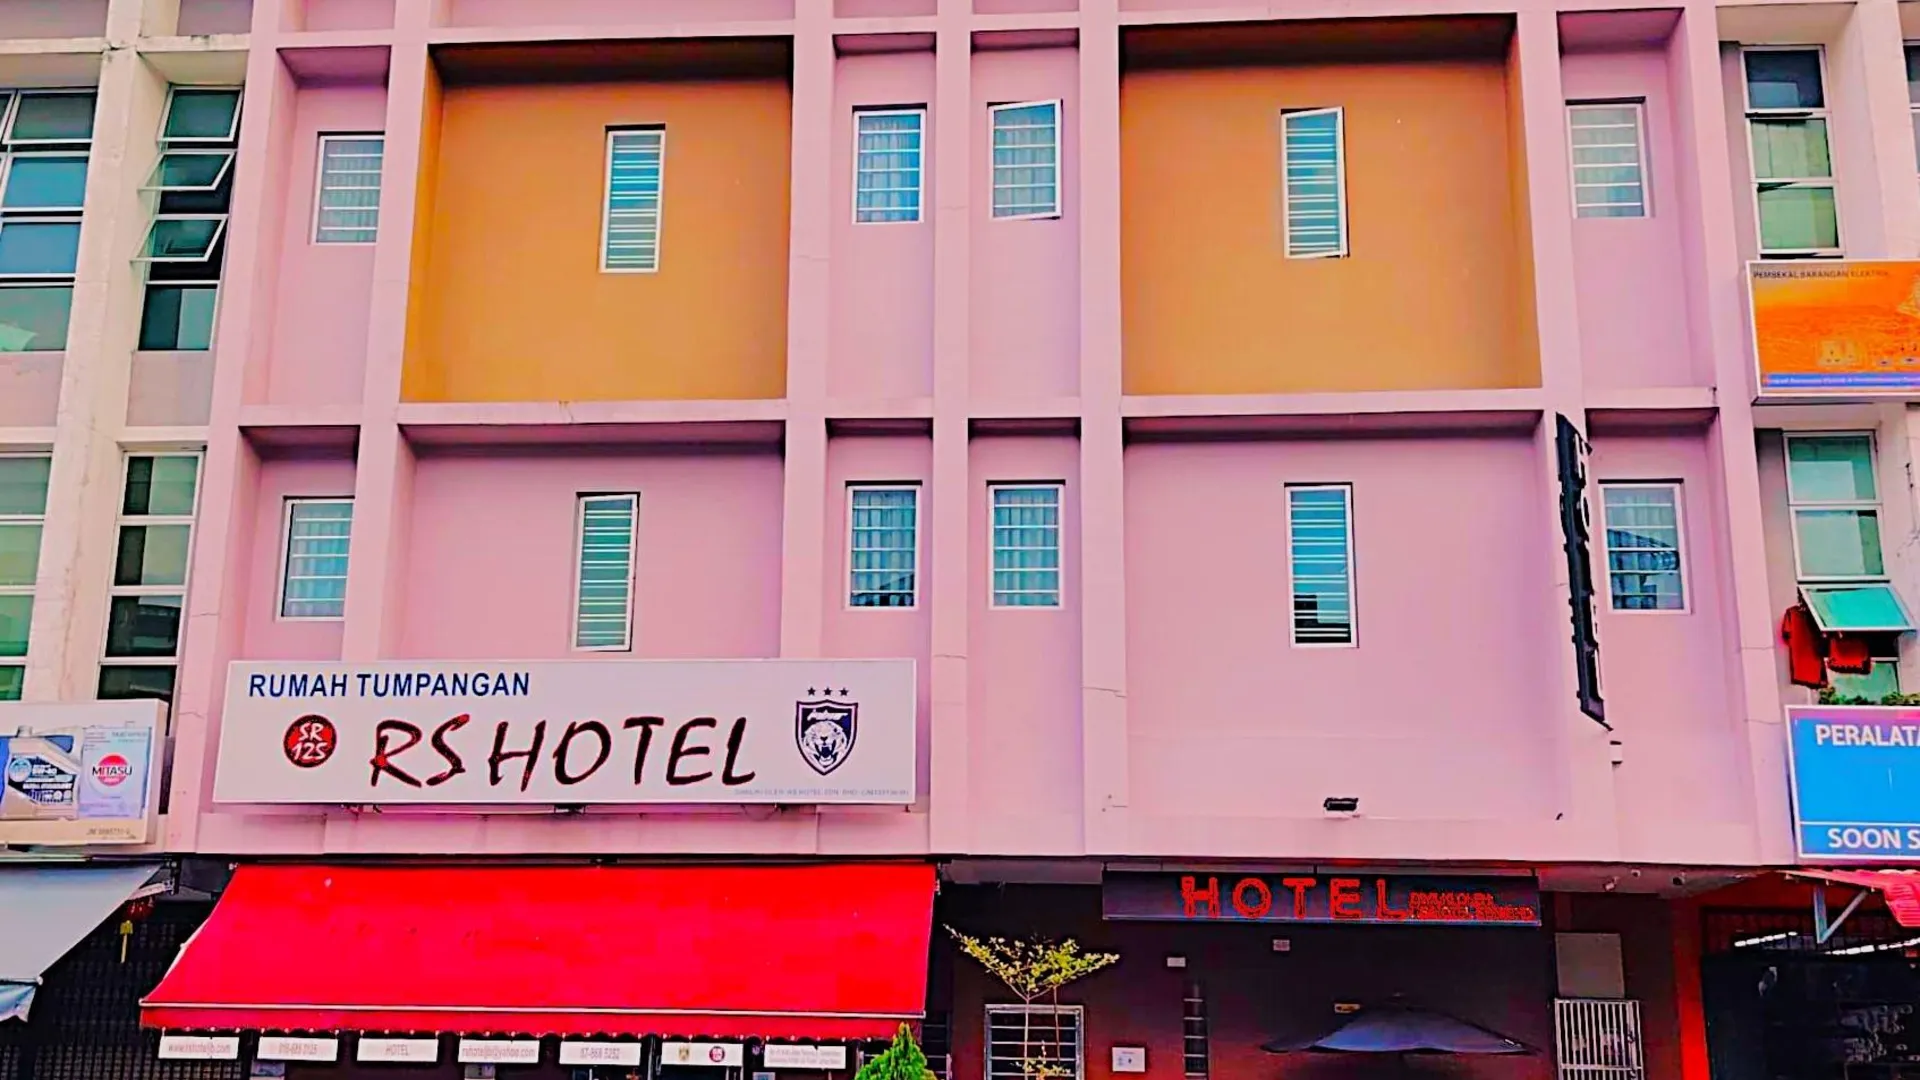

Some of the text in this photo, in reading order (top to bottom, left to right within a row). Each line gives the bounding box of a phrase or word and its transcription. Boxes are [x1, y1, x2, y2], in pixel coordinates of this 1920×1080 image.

[249, 672, 529, 697] RUMAH TUMPANGAN
[299, 722, 323, 741] SR
[1815, 723, 1920, 747] PERALAT
[369, 713, 755, 792] RS HOTEL
[92, 765, 133, 776] MITASU
[1827, 827, 1902, 849] SOON
[1181, 876, 1406, 919] HOTEL
